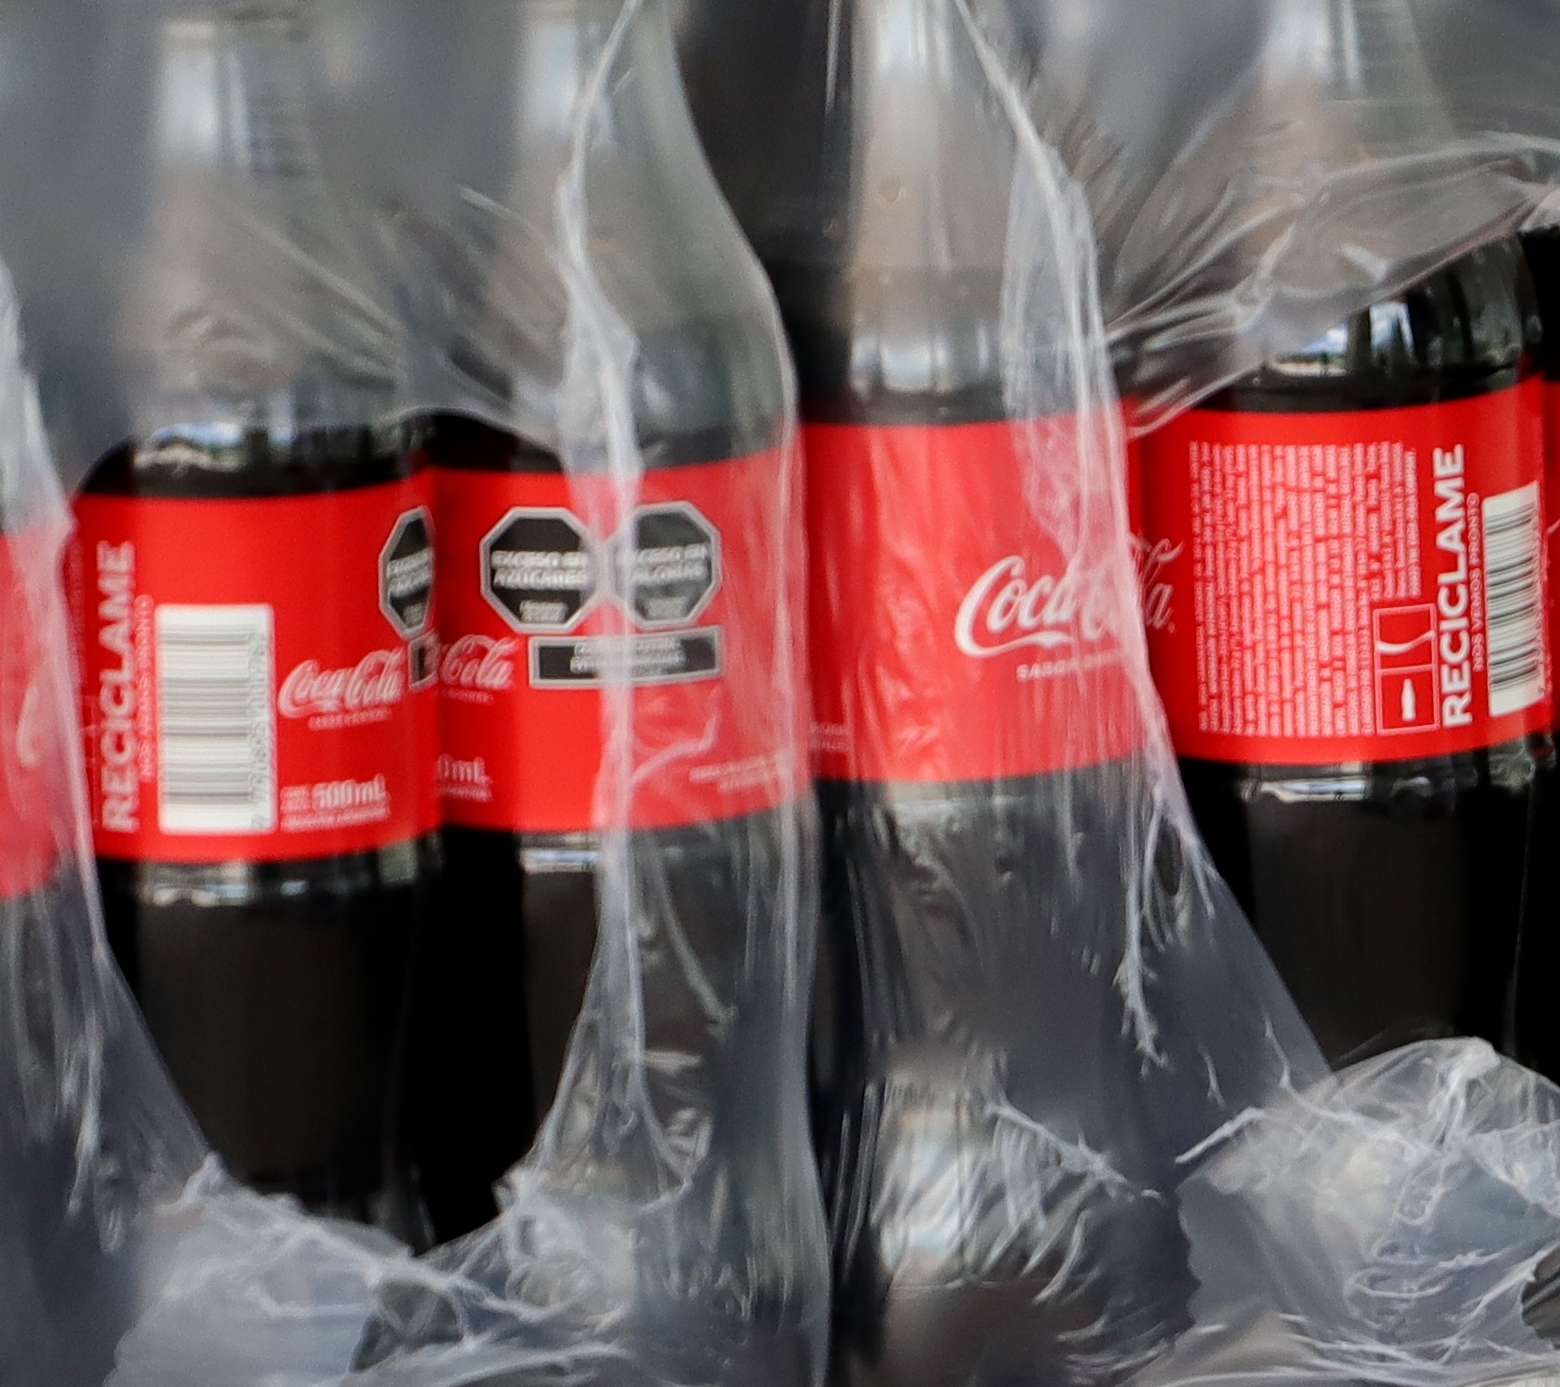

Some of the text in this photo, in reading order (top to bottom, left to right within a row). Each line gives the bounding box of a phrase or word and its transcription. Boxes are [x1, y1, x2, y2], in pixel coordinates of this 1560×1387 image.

[1432, 443, 1474, 729] RECICLAME
[1466, 492, 1481, 567] PRONTO
[95, 540, 139, 833] RECICLAME
